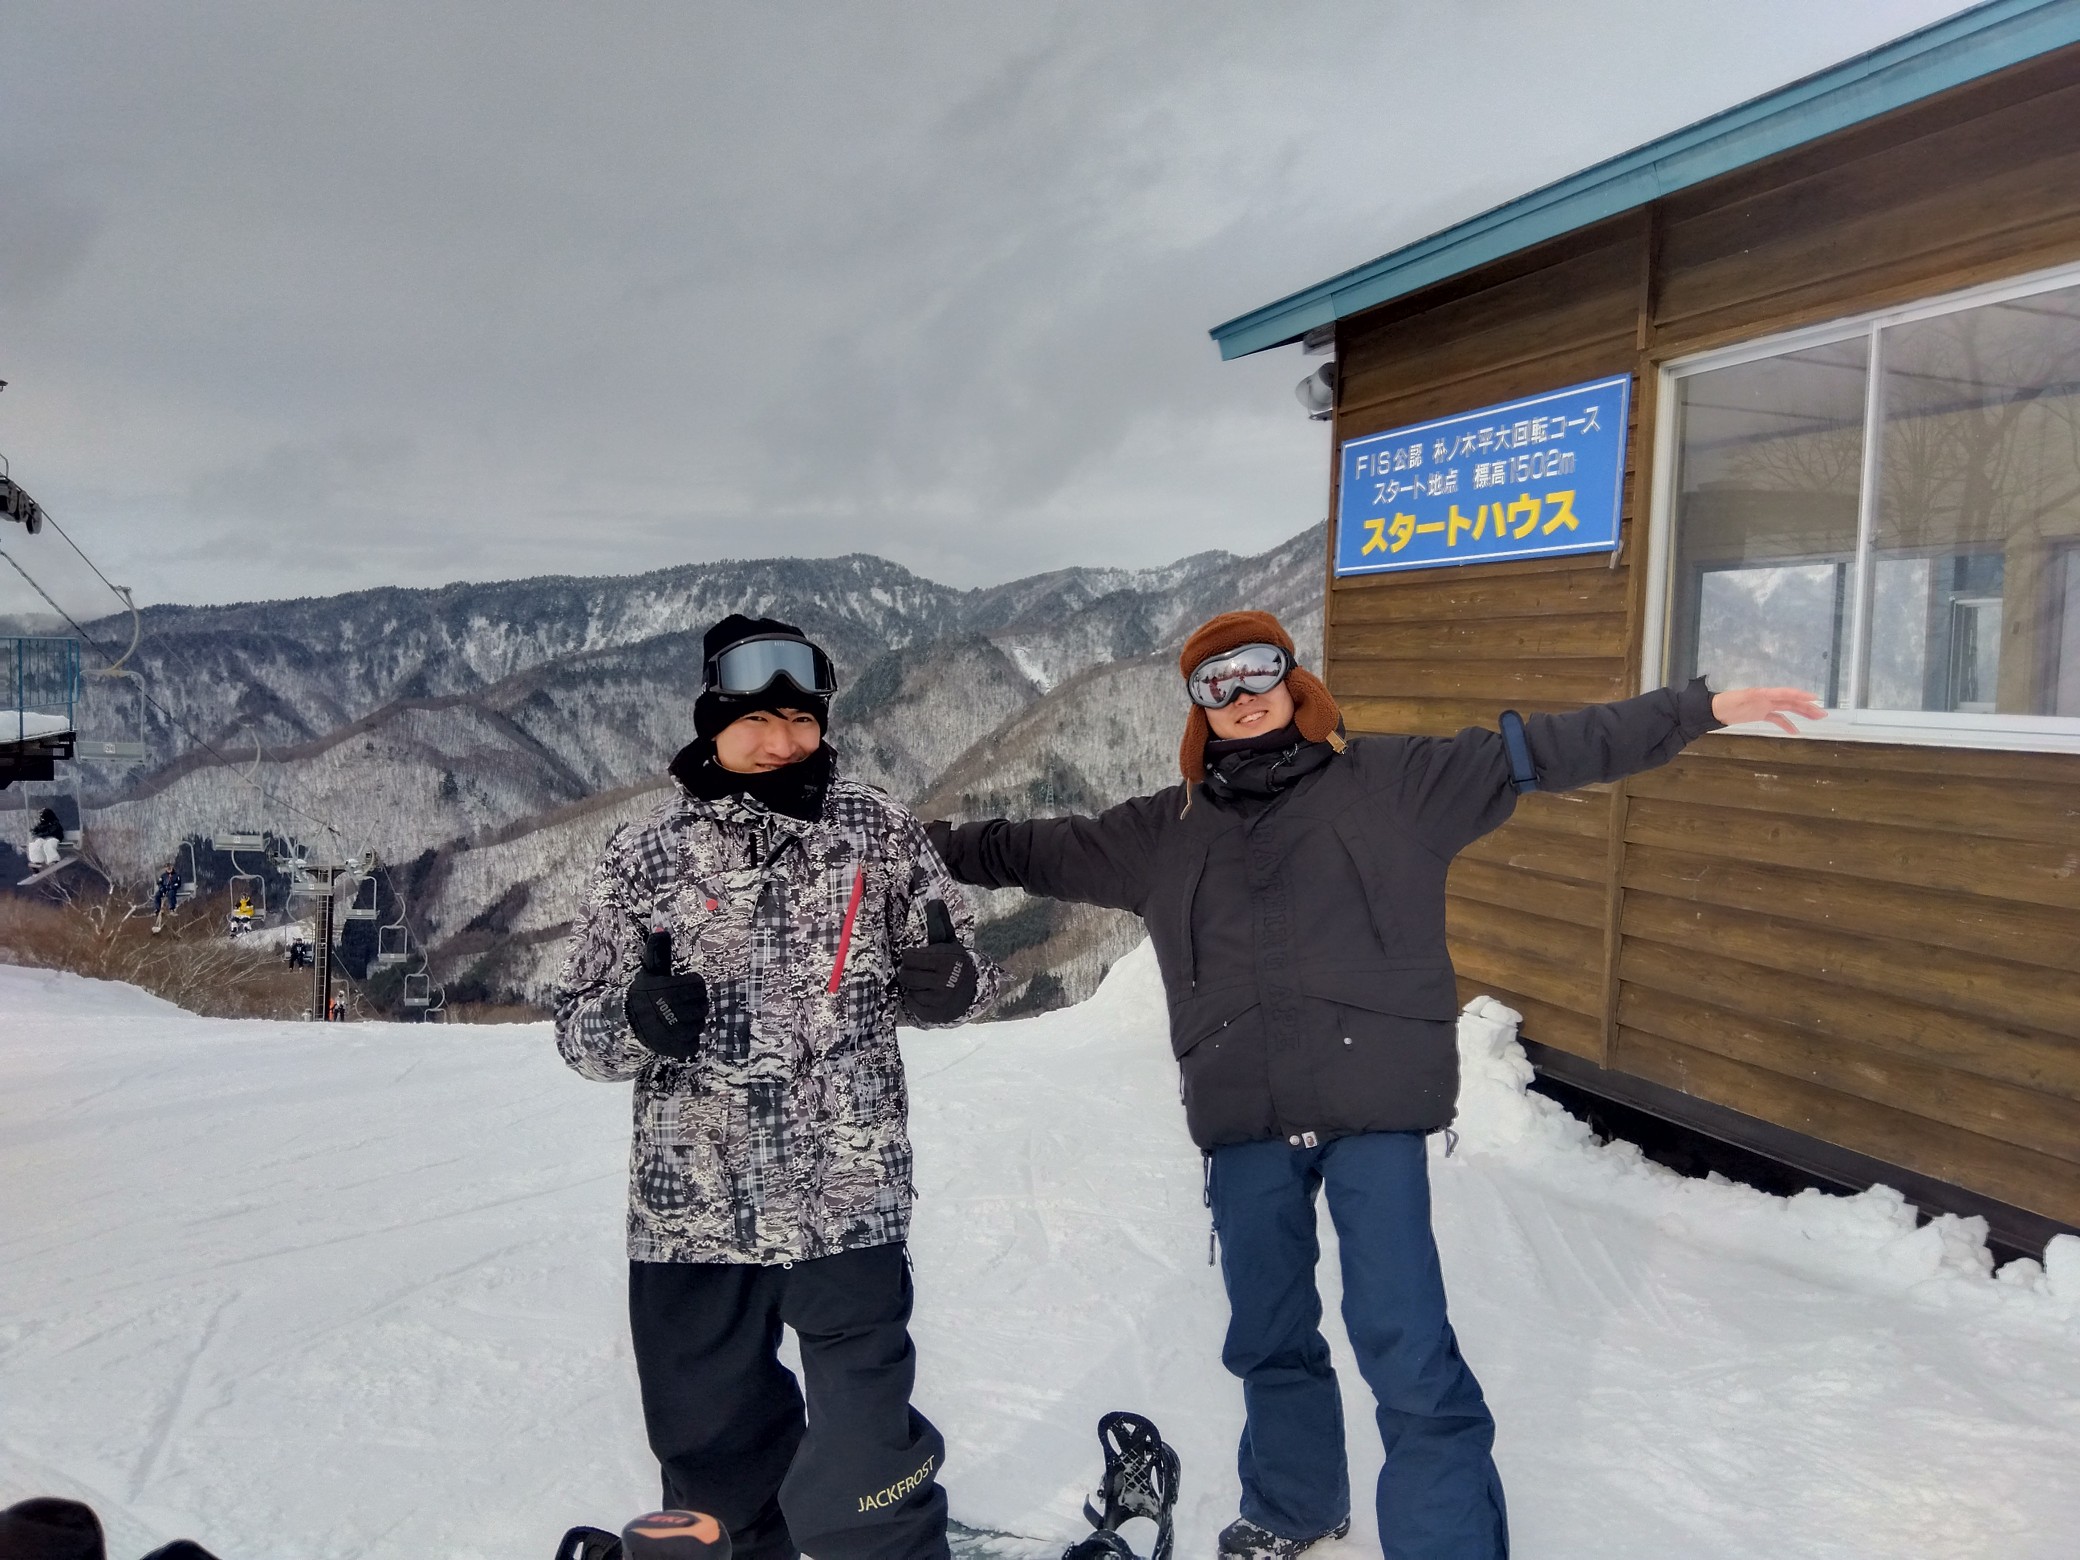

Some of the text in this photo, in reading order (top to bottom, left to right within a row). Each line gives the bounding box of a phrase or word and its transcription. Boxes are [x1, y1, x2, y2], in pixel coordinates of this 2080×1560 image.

[1355, 442, 1423, 480] FIS公認
[1372, 448, 1576, 506] スタート地点 標高1502m
[1361, 489, 1580, 557] スタートハウス
[946, 960, 964, 989] VOICE
[655, 997, 678, 1026] VOICE
[858, 1454, 935, 1512] JACKFROST
